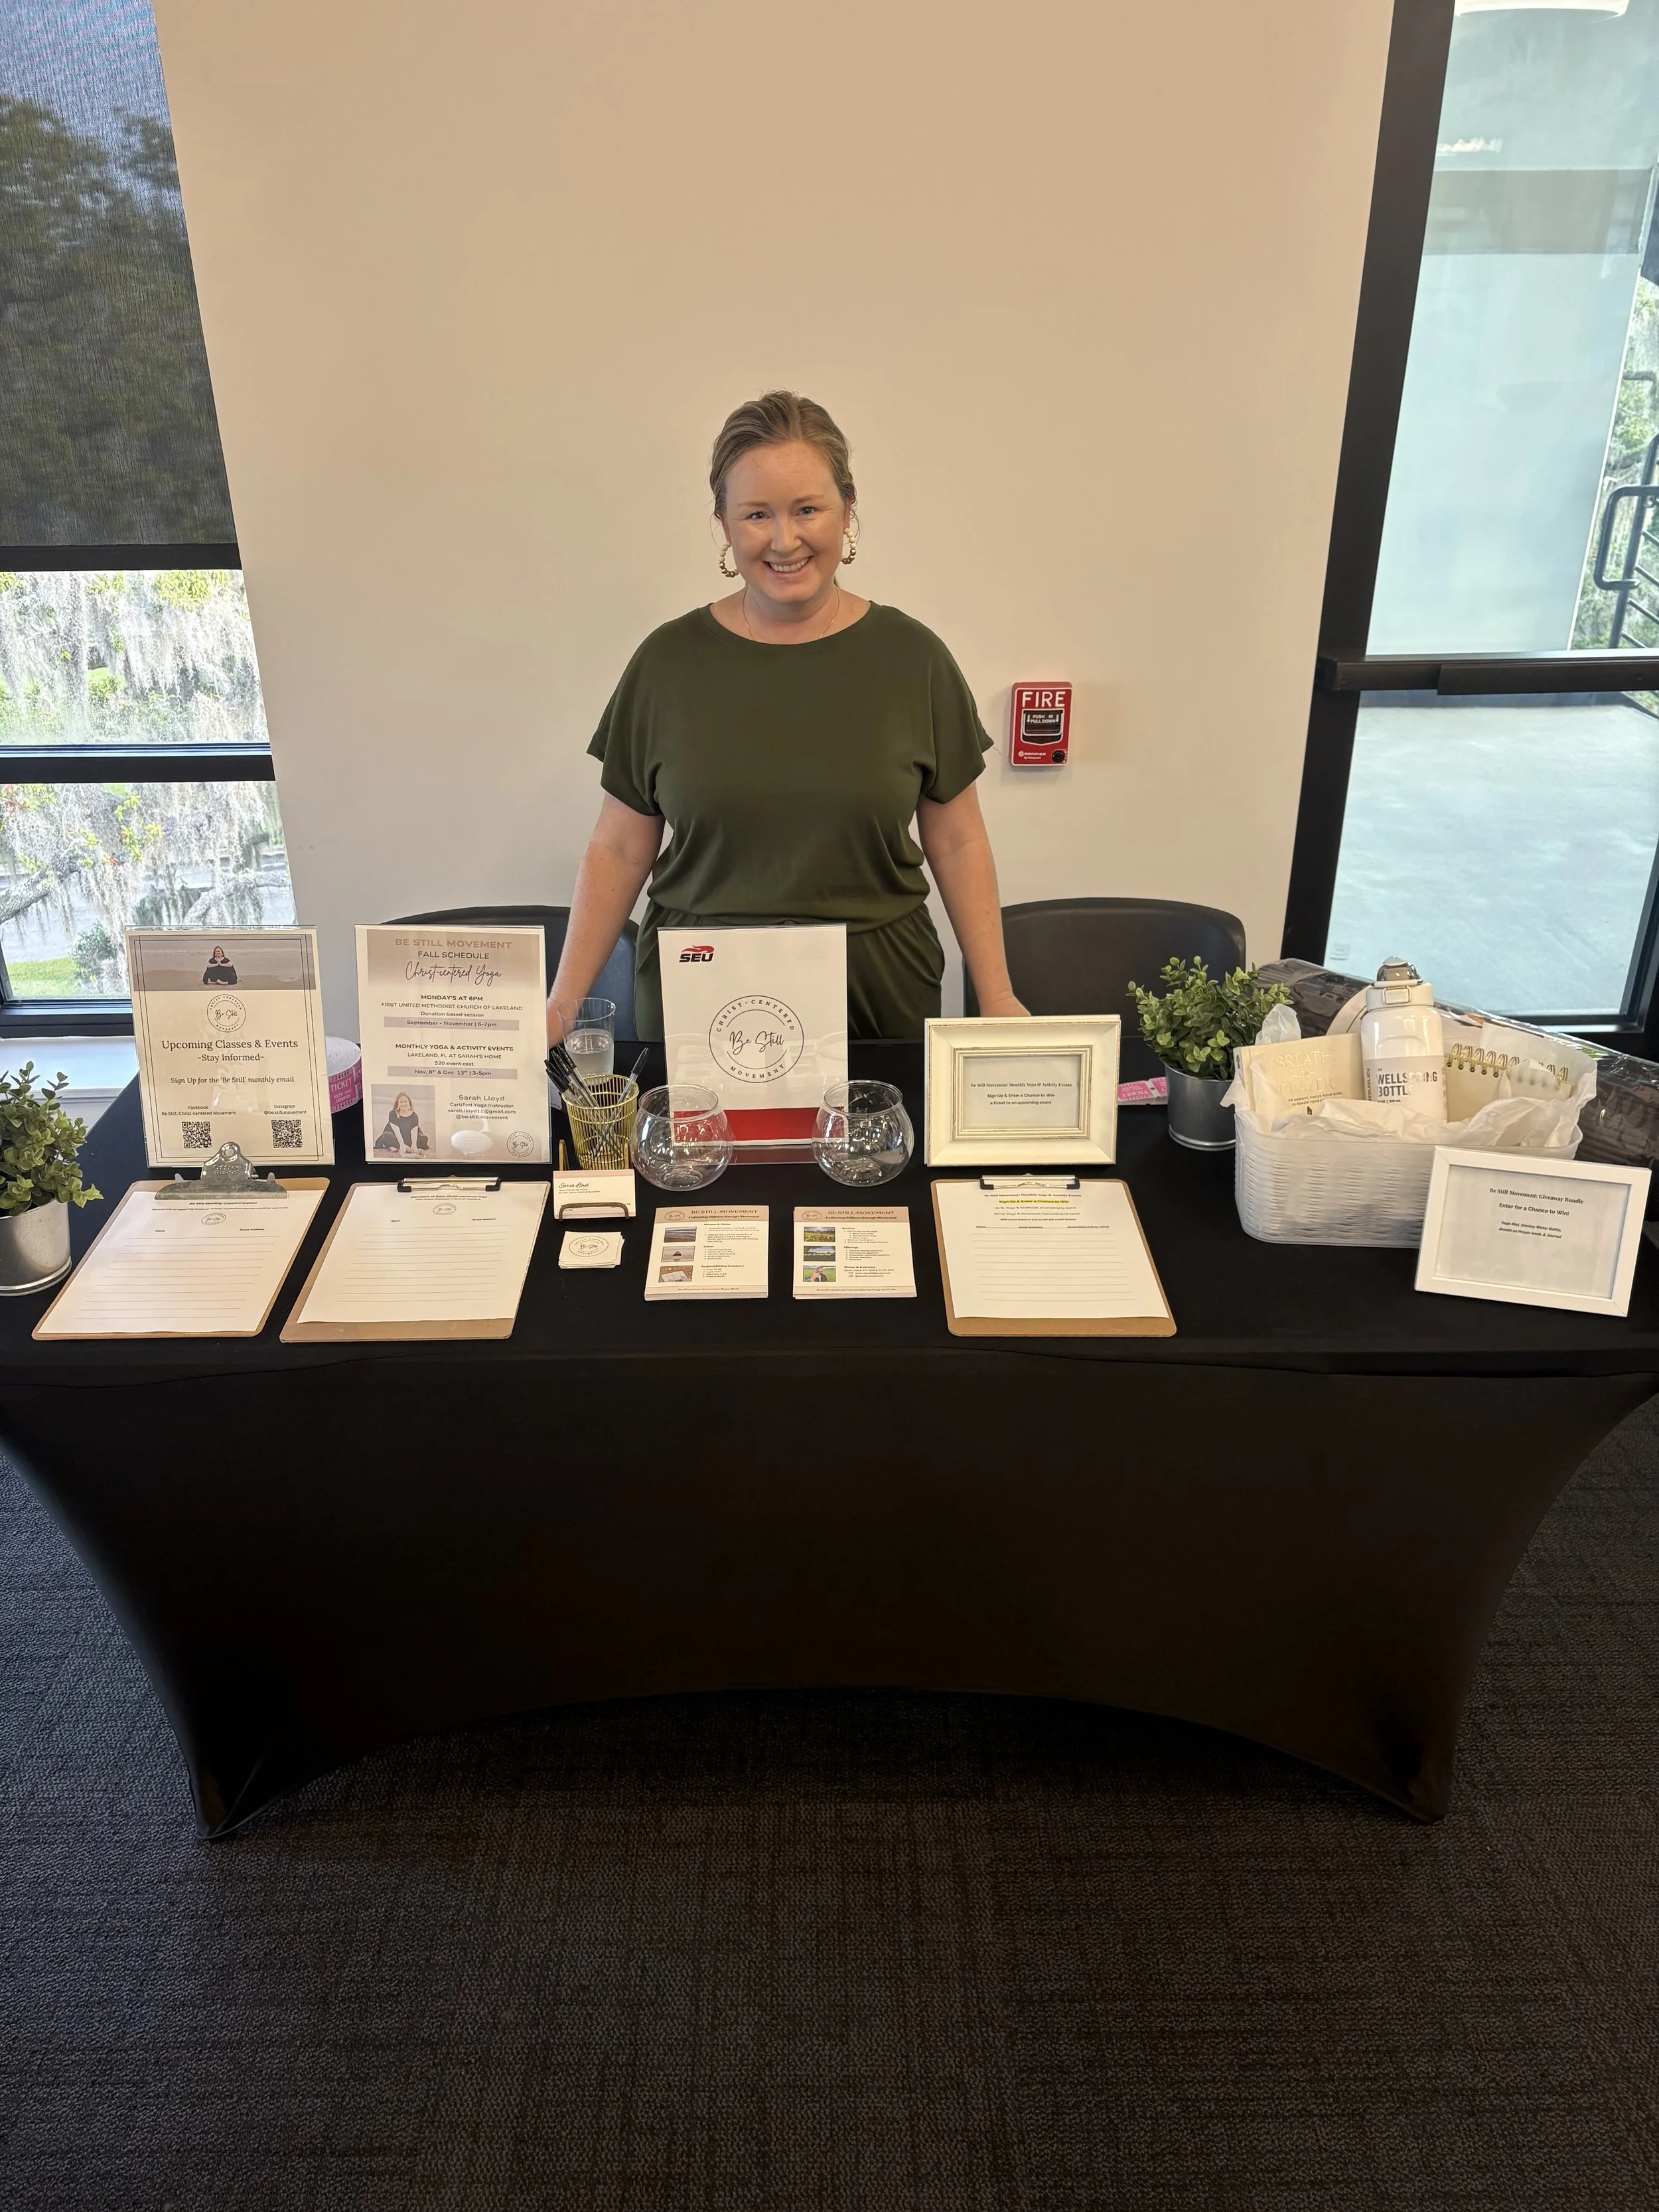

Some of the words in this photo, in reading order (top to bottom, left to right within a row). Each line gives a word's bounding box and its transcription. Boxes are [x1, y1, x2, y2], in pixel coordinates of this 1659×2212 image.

[1023, 692, 1066, 707] FIRE
[447, 940, 512, 948] MOVEMENT
[679, 953, 713, 962] SEU
[405, 961, 472, 983] Christ-centered
[474, 964, 502, 987] Yoga
[215, 1009, 224, 1020] Be
[226, 1009, 238, 1019] Still
[716, 999, 794, 1033] CHRIST-CENTERED
[162, 1040, 213, 1051] Upcoming
[215, 1040, 252, 1049] Classes
[265, 1039, 298, 1048] Events
[729, 1031, 753, 1055] Be
[755, 1031, 784, 1053] Still
[198, 1054, 220, 1063] -Stay
[729, 1064, 785, 1079] MOVEMENT
[330, 1077, 352, 1092] TICKET
